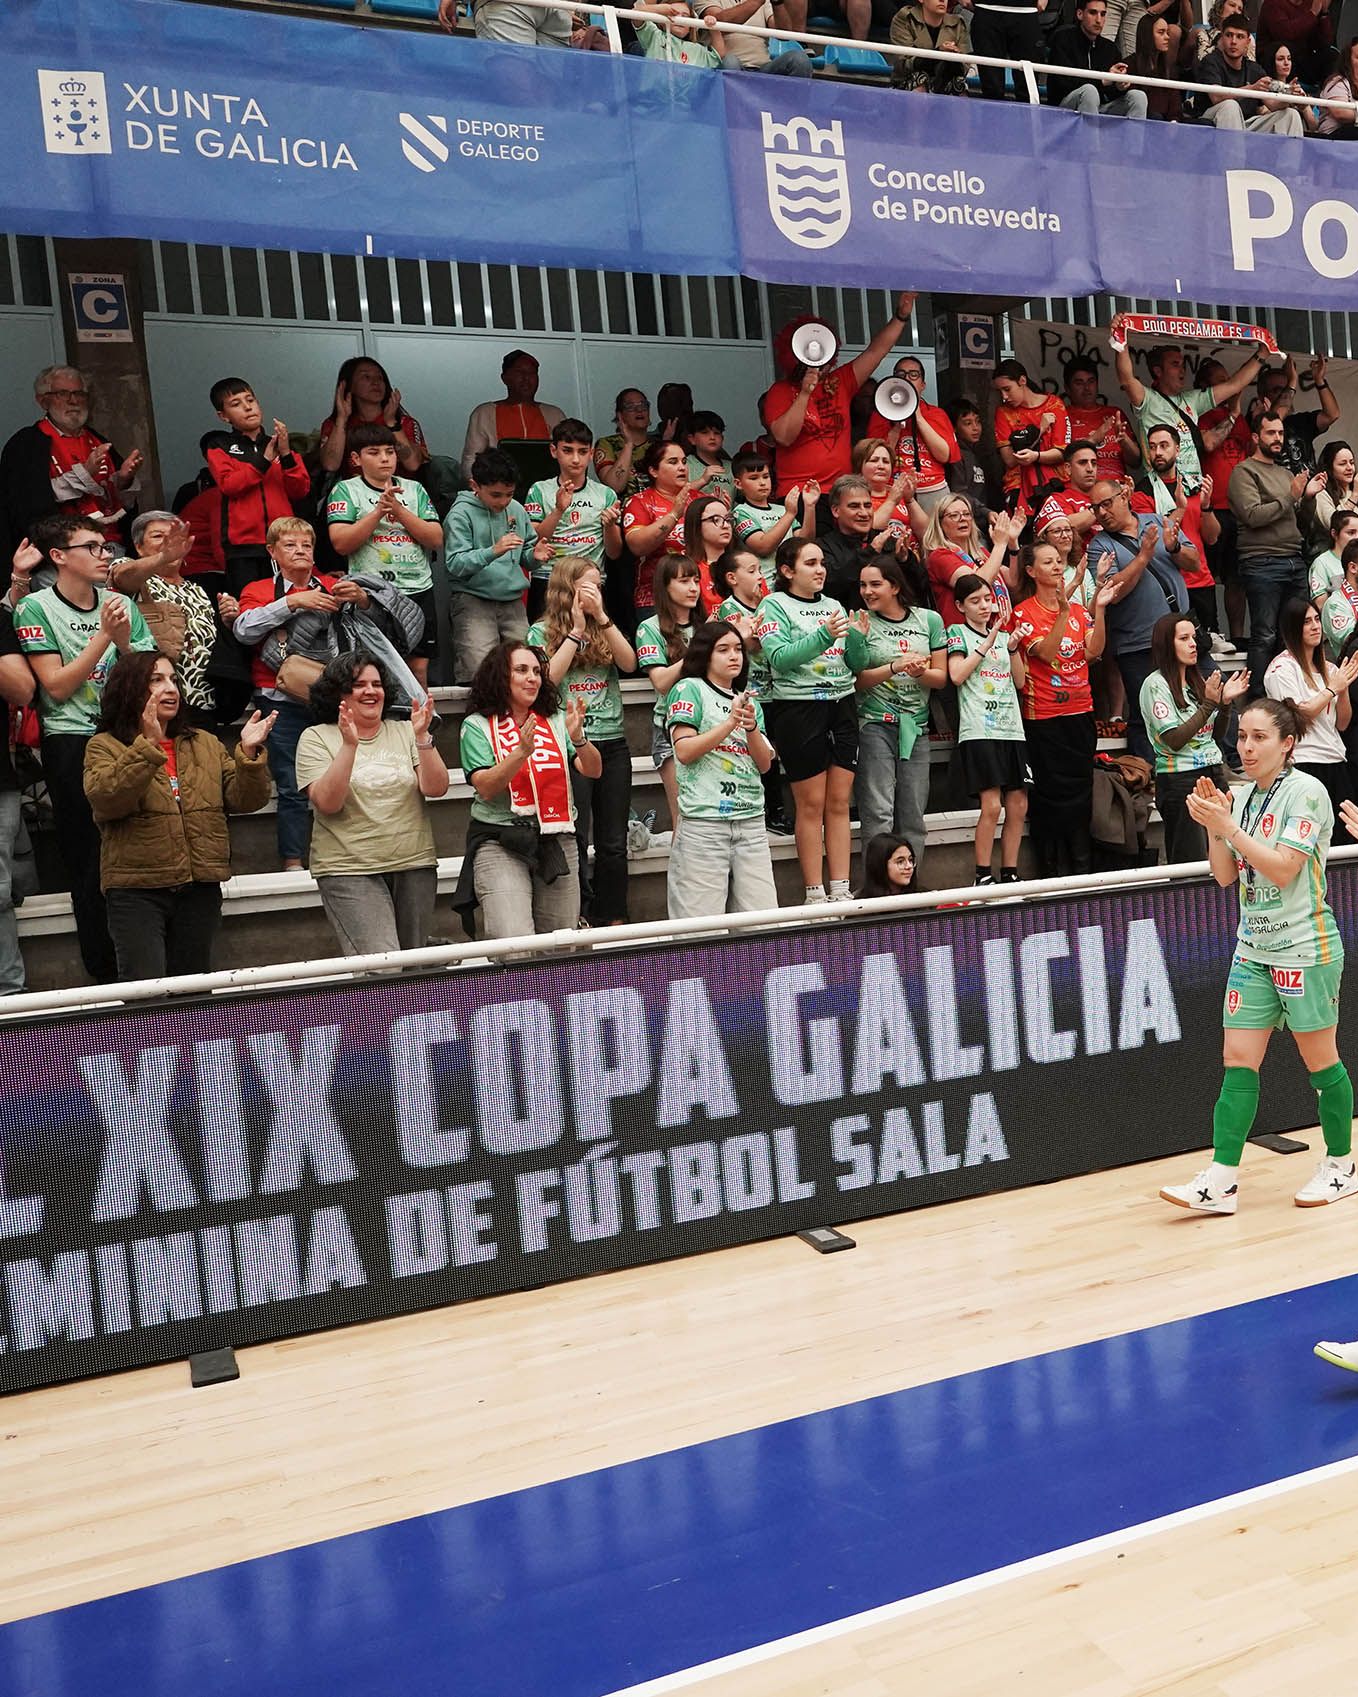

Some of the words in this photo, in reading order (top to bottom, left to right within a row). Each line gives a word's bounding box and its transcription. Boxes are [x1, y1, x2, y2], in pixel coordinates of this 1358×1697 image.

[123, 82, 268, 127] XUNTA
[457, 119, 545, 141] DEPORTE
[126, 120, 180, 154] DE
[196, 128, 359, 172] GALICIA
[459, 141, 539, 163] GALEGO
[868, 163, 985, 195] Concello
[872, 197, 907, 221] de
[913, 199, 1061, 233] Pontevedra
[82, 289, 119, 324] C
[1143, 319, 1166, 332] POIO
[1170, 323, 1224, 339] PESCAMAR
[965, 327, 988, 354] C
[905, 456, 931, 468] ece
[524, 503, 542, 514] ROIZ
[569, 500, 593, 508] ACAL
[373, 535, 414, 544] PESCAM
[70, 621, 101, 632] CARAC
[756, 622, 779, 637] ROIZ
[637, 645, 658, 658] ROIZ
[671, 700, 694, 713] ROIZ
[1254, 884, 1282, 903] nce
[1272, 968, 1303, 989] ROIZ
[78, 1024, 359, 1224] XIX
[389, 977, 741, 1170] COPA
[764, 918, 1182, 1107] GALICIA
[0, 1205, 368, 1354] MININA
[384, 1180, 498, 1280] DE
[514, 1127, 815, 1256] FÚTBOL
[829, 1091, 1011, 1192] SALA
